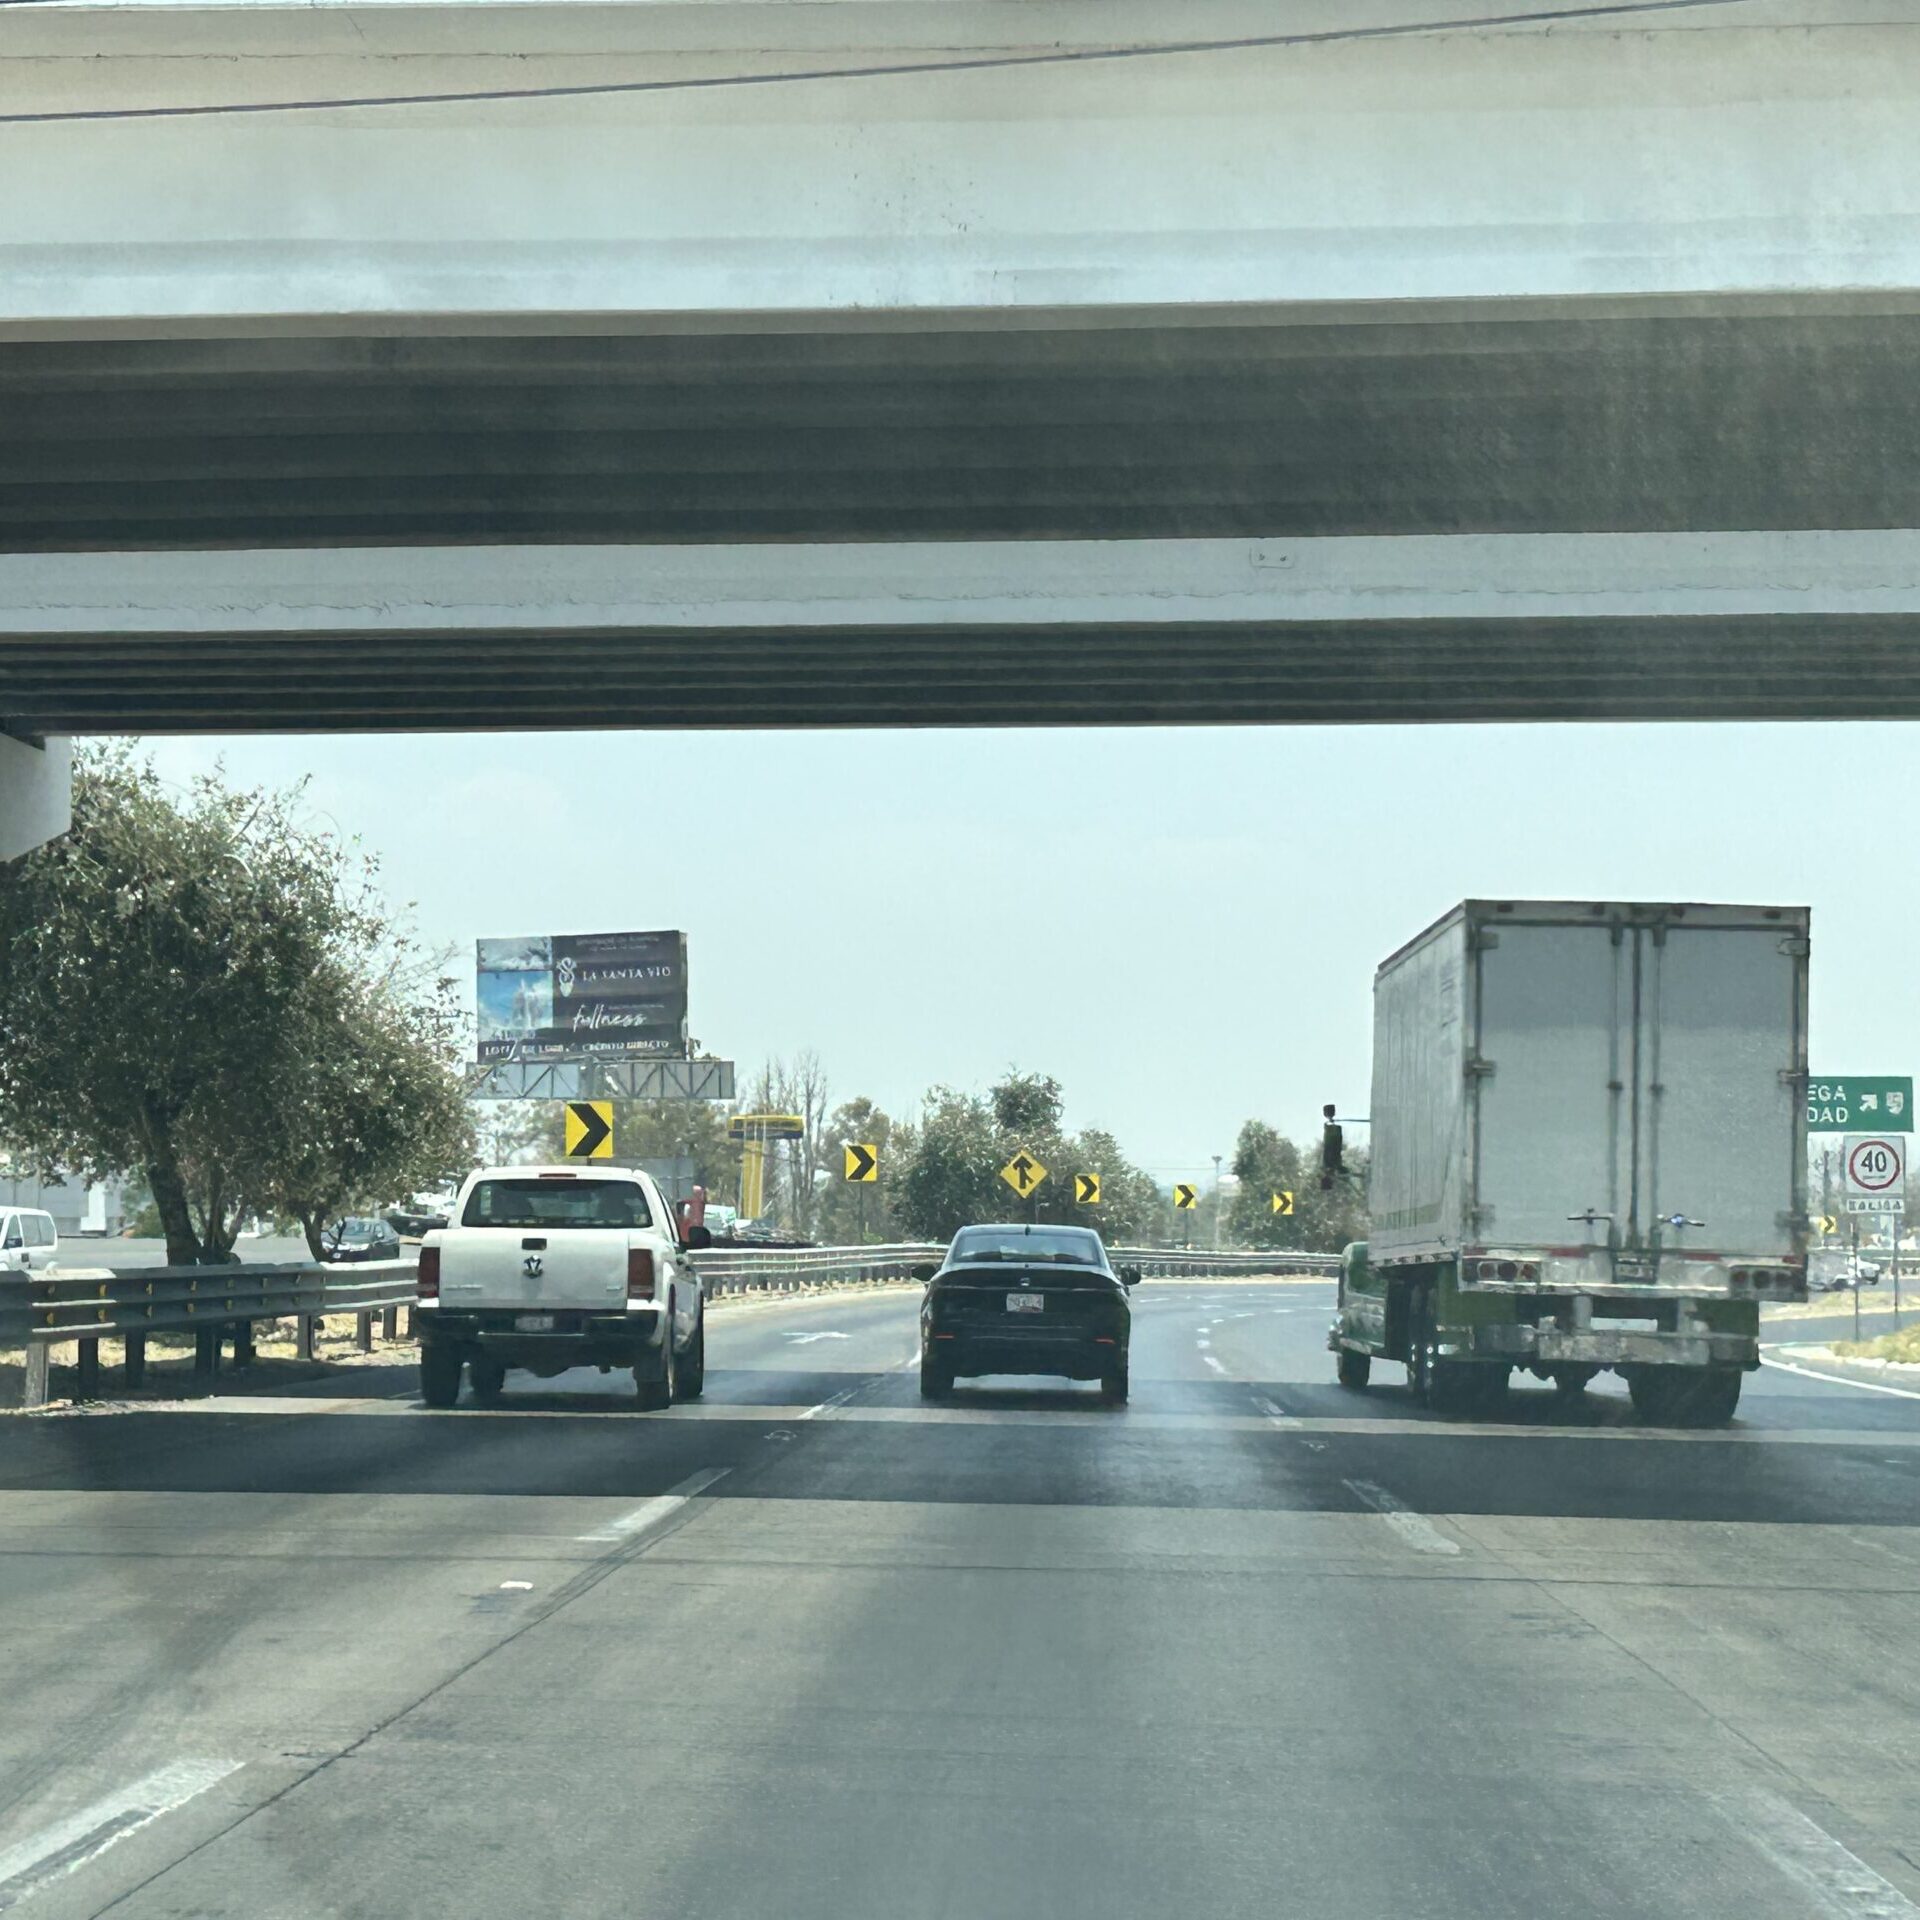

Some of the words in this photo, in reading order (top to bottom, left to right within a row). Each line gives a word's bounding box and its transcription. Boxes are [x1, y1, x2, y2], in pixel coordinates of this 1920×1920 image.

[602, 968, 643, 979] SANTA
[1808, 1107, 1848, 1123] DAD
[1861, 1150, 1887, 1172] 40
